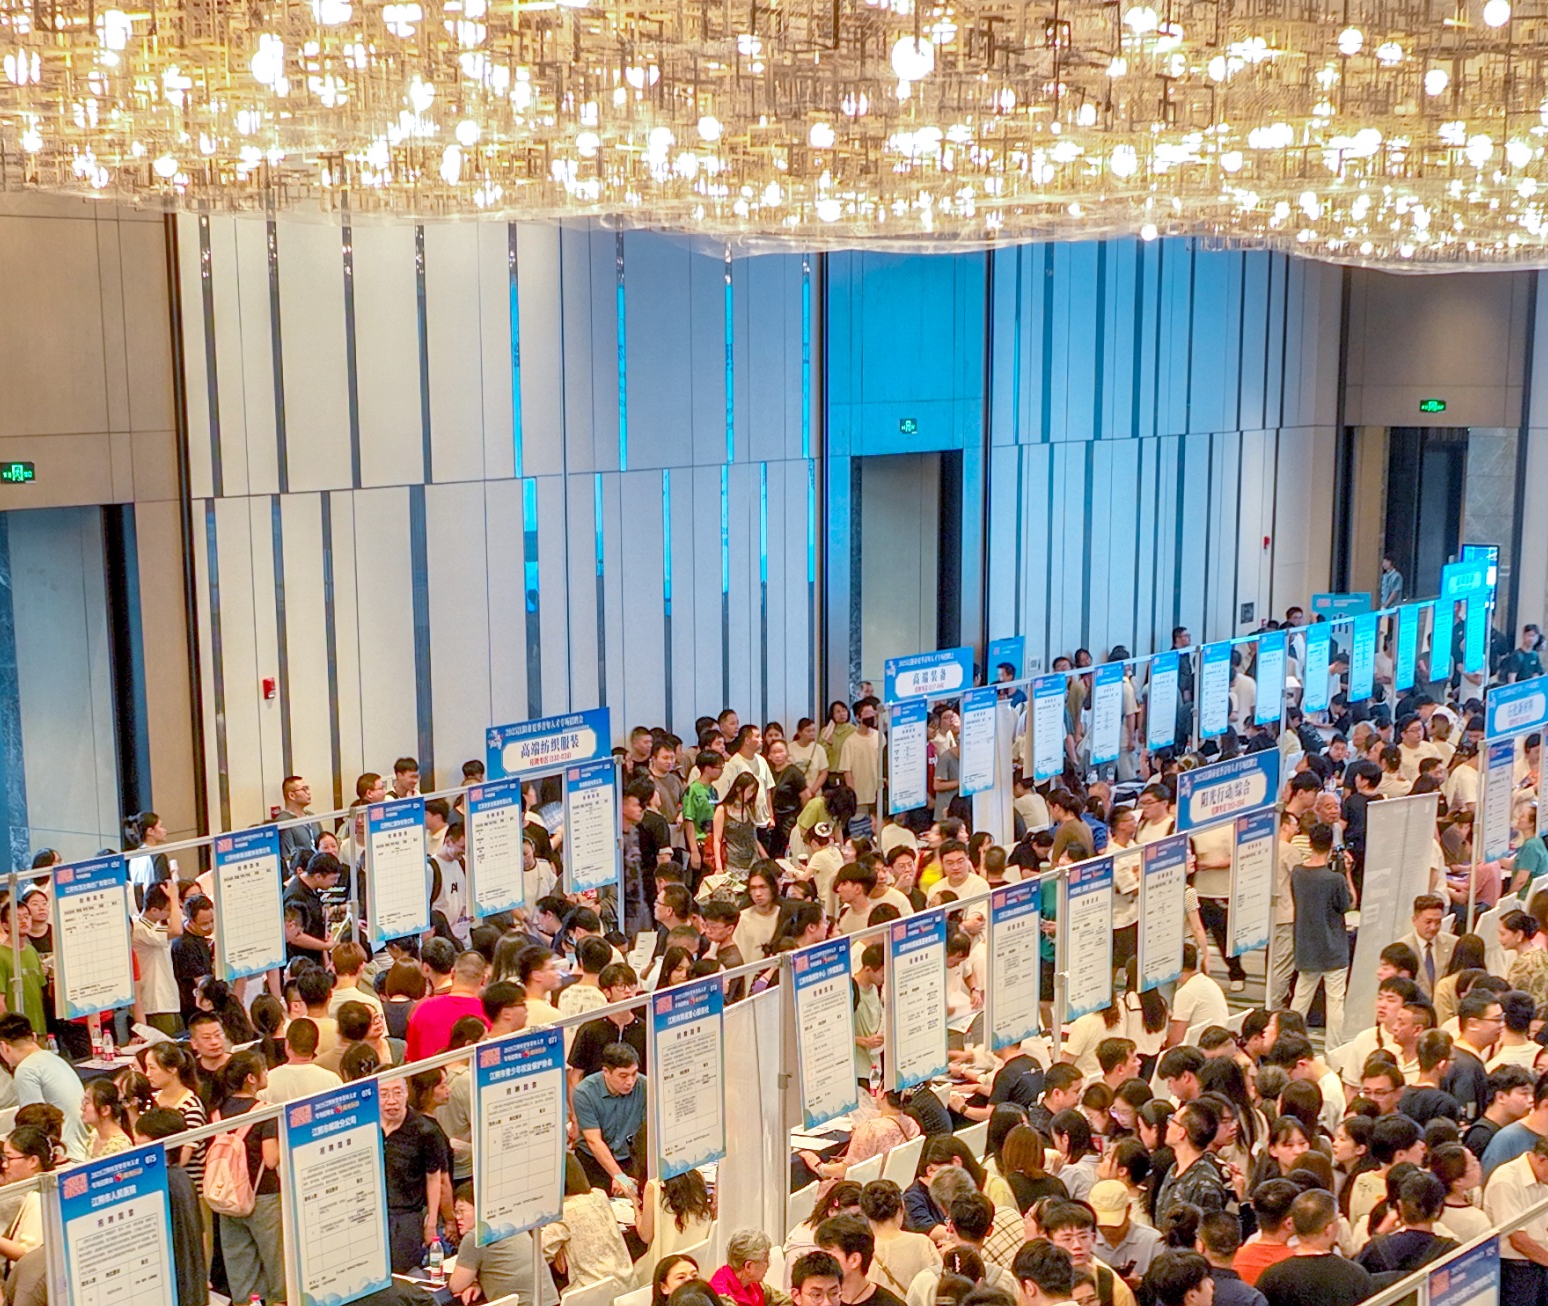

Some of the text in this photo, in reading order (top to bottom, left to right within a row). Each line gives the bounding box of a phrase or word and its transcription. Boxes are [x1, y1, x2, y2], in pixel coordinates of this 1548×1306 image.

[521, 734, 579, 759] 高端纺织服装
[144, 1153, 157, 1165] 075
